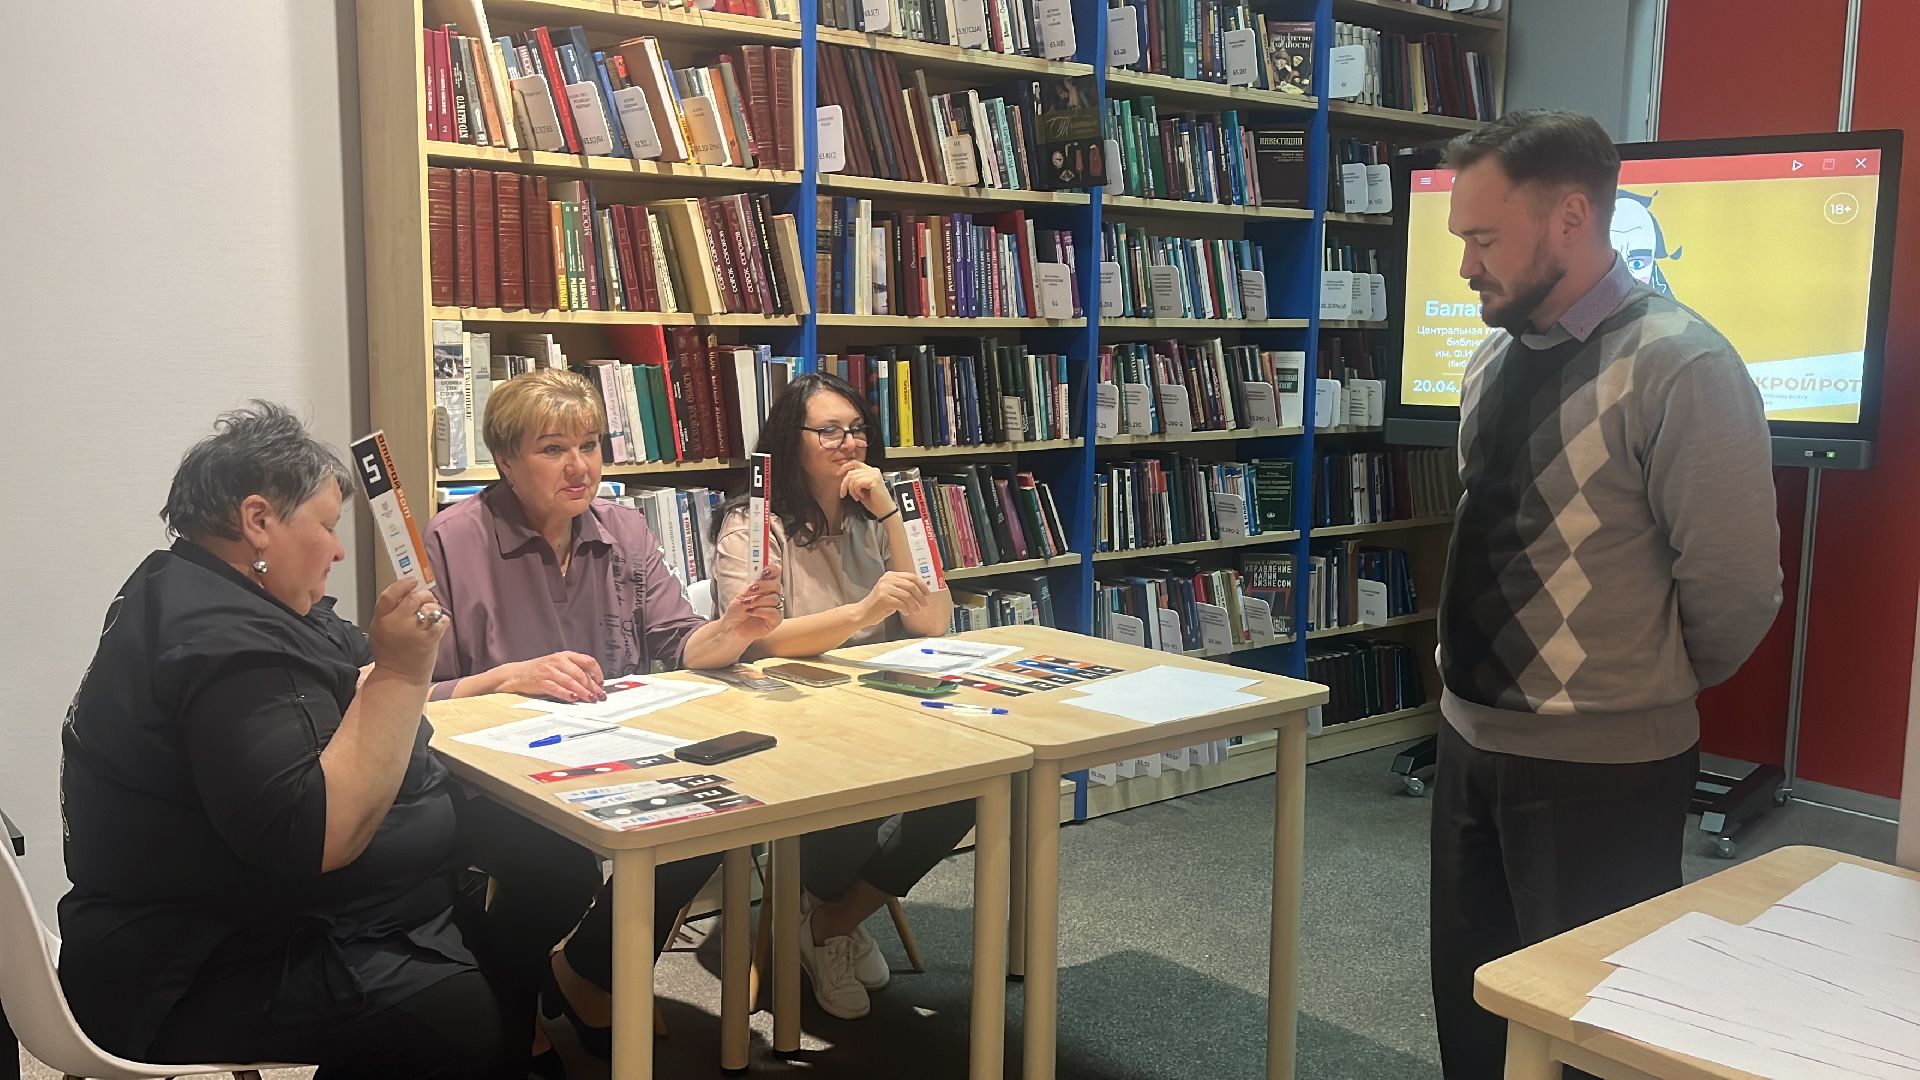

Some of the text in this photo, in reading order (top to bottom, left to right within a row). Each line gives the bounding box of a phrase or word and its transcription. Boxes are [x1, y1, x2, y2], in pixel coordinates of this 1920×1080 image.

[456, 95, 466, 110] КТО
[458, 110, 467, 124] БЫЛ
[459, 124, 469, 138] КТО
[582, 200, 593, 236] МОСКВА
[1830, 204, 1852, 215] 18+
[706, 228, 726, 291] СОРОК СОРОКОВ
[719, 230, 738, 293] СОРОК СОРОКОВ
[735, 231, 754, 293] СОРОК СОРОКОВ
[558, 274, 568, 308] КУРАНТЫ
[570, 278, 578, 308] КУРАНТЫ
[578, 277, 588, 308] КУРАНТЫ
[1417, 326, 1482, 336] Центральная
[1820, 378, 1861, 392] РОТ
[362, 454, 382, 484] 5
[753, 466, 763, 487] 6
[901, 492, 916, 512] 6
[1244, 565, 1292, 574] УПРАВЛЕНИЕ
[694, 789, 722, 799] 2
